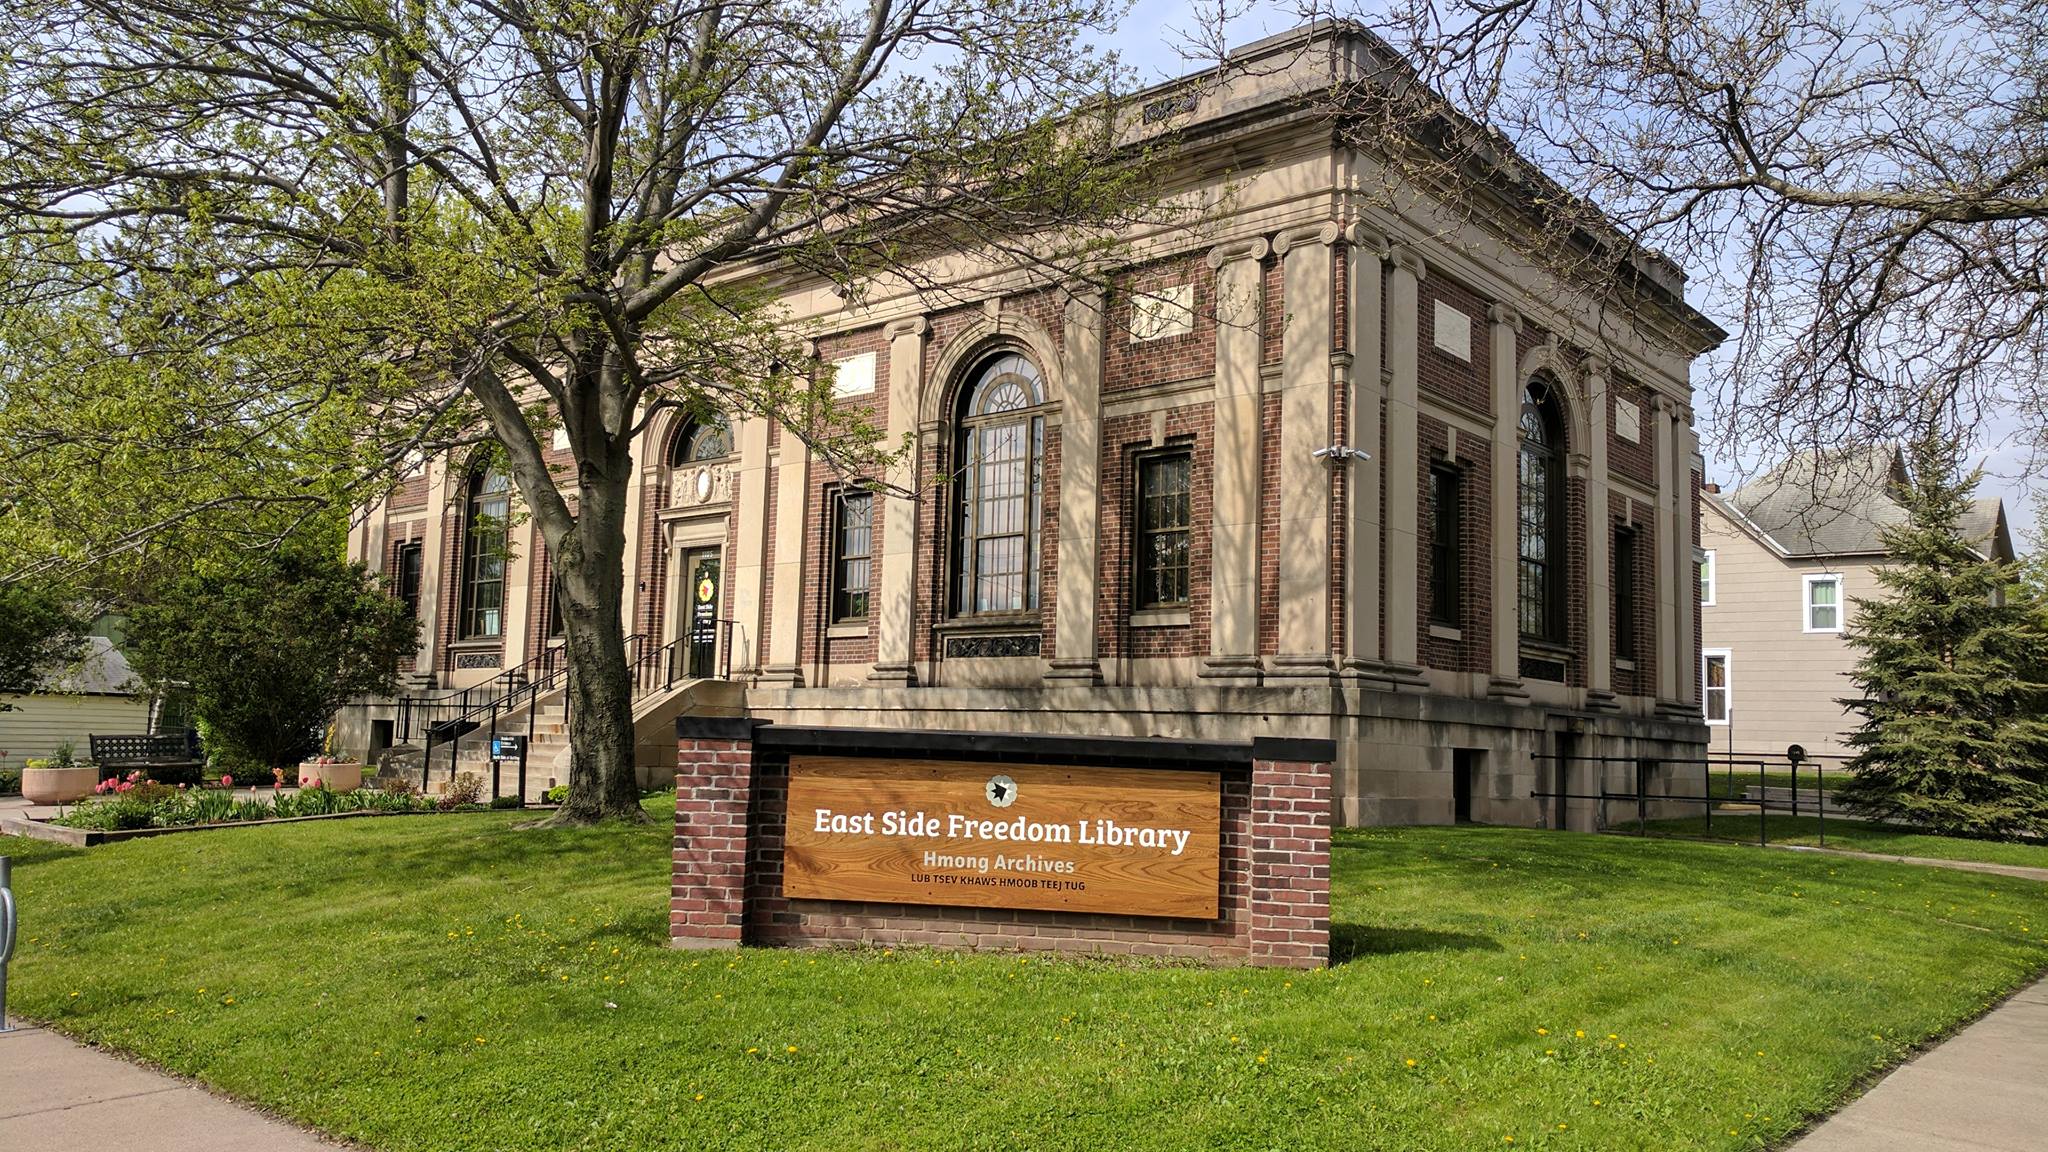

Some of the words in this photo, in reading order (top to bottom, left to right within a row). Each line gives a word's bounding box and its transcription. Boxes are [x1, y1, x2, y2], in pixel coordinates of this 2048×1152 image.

[814, 808, 874, 835] East
[881, 810, 940, 837] Side
[947, 814, 1071, 843] Freedom
[1078, 819, 1190, 856] Library
[923, 850, 989, 873] Hmong
[993, 854, 1075, 873] Archives
[911, 873, 931, 883] LUB
[933, 874, 957, 884] TSEV
[960, 876, 997, 886] KHAWS
[999, 878, 1038, 888] HMOOB
[1040, 880, 1063, 891] TEEJ
[1065, 881, 1085, 891] TUG
